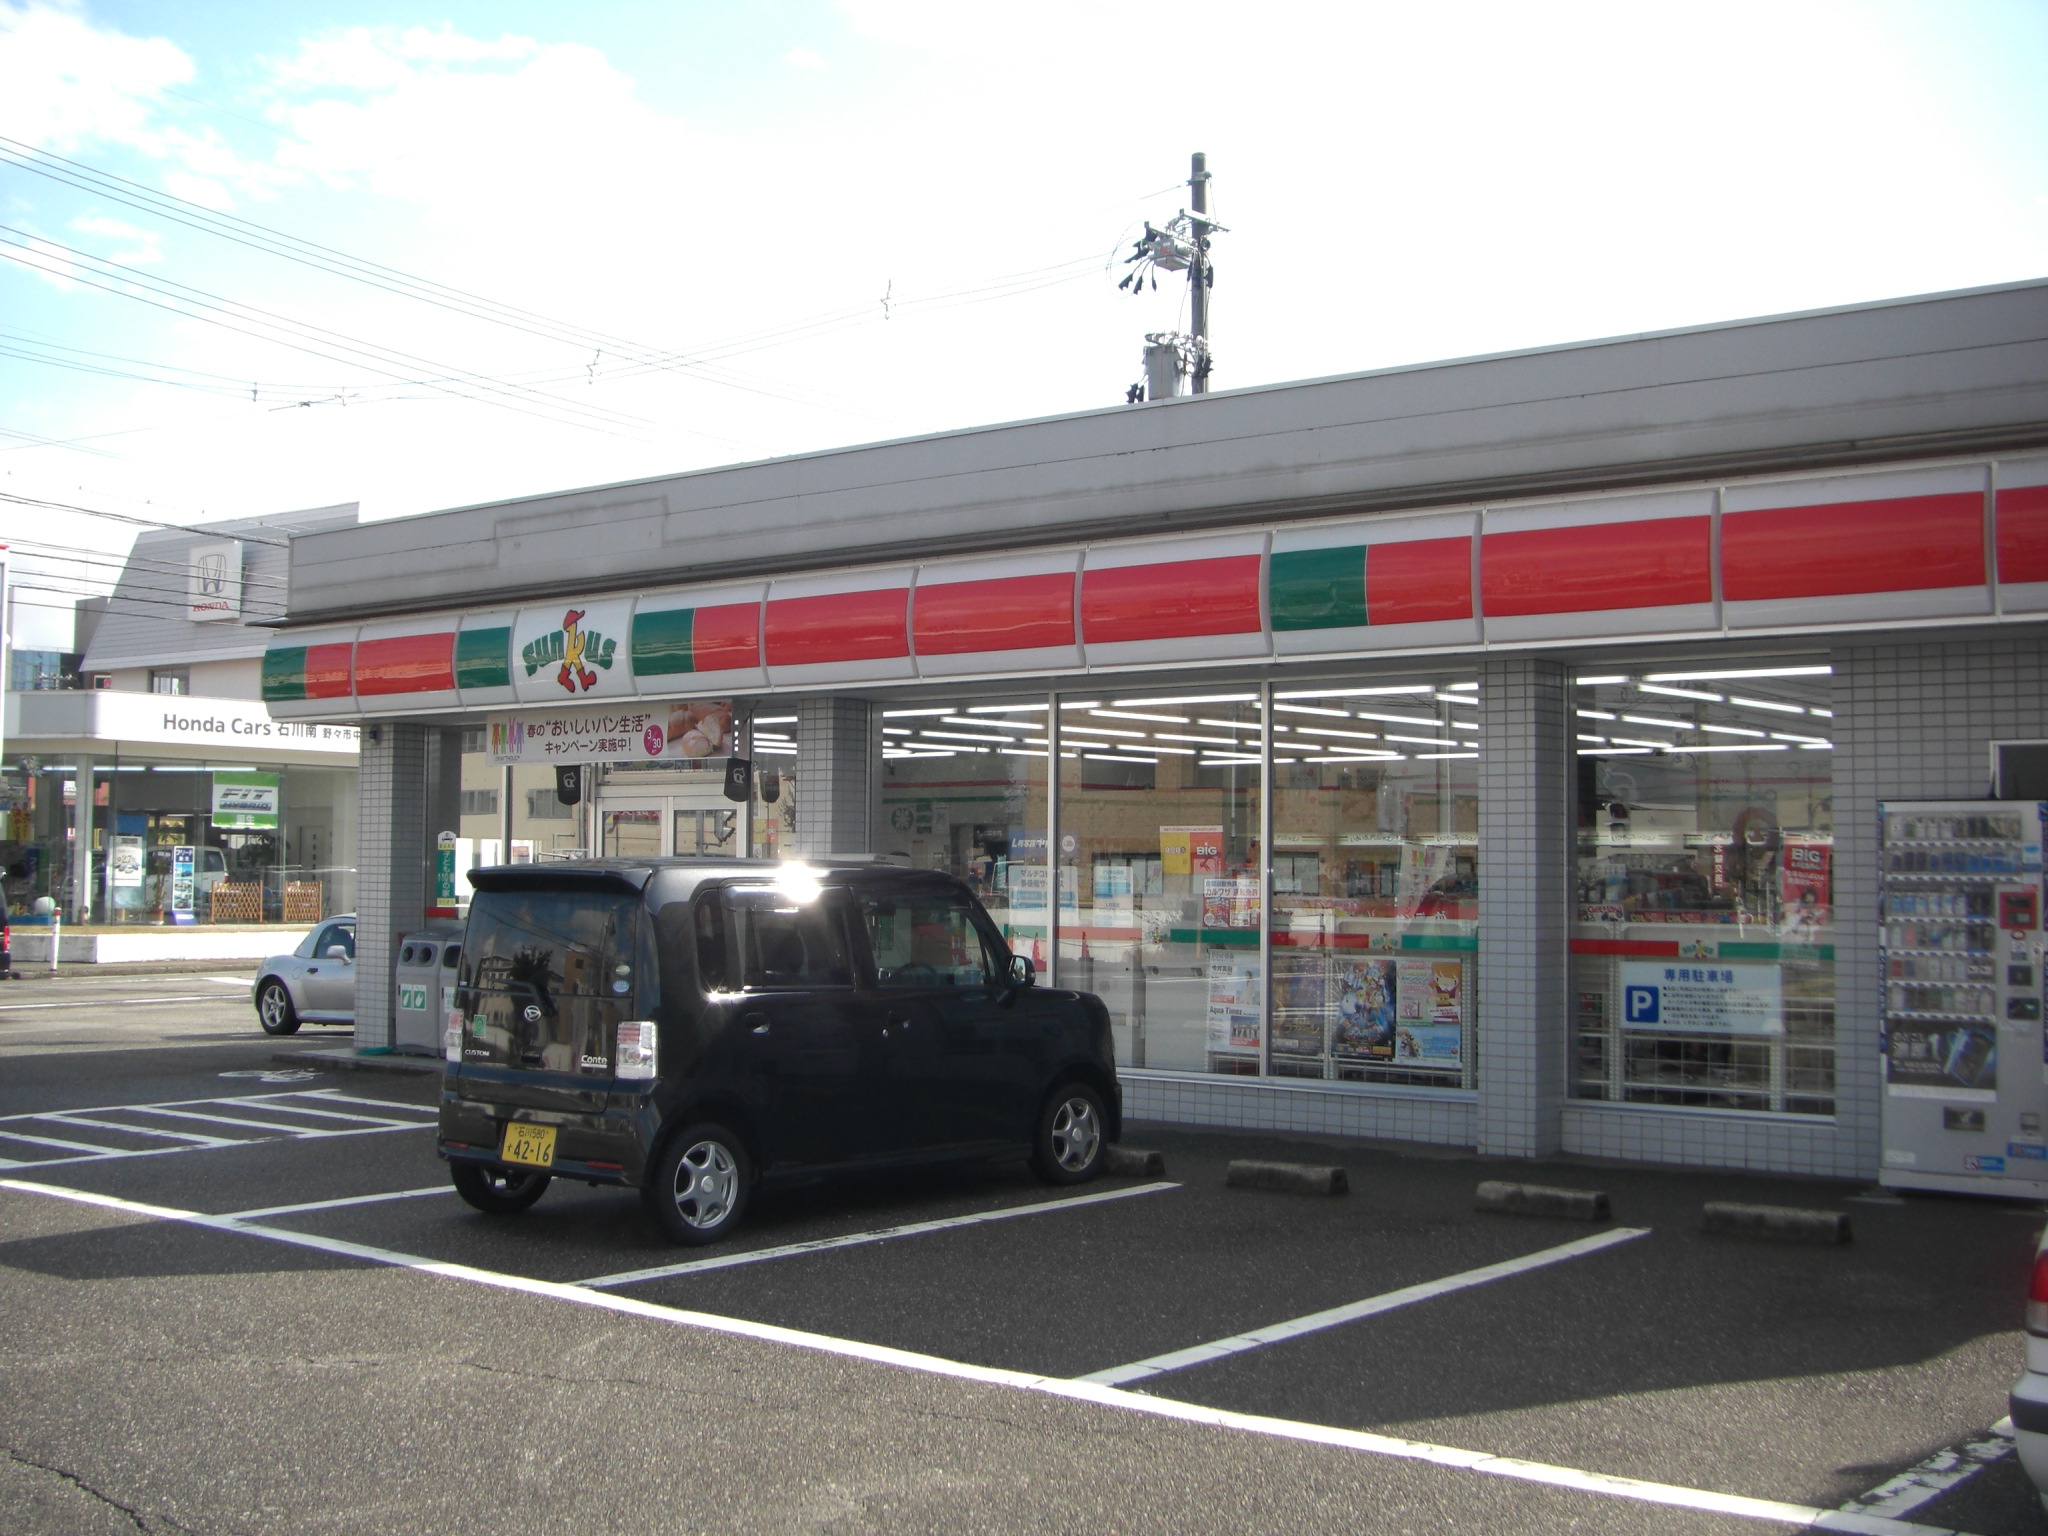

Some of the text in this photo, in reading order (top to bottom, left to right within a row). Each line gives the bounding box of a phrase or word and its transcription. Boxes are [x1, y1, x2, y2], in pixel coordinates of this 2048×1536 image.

[163, 713, 225, 733] Honda
[231, 718, 271, 736] Cars
[278, 722, 317, 738] 石川南
[1663, 968, 1733, 983] 専用駐車場
[1631, 989, 1653, 1018] P
[581, 1054, 608, 1065] Conte
